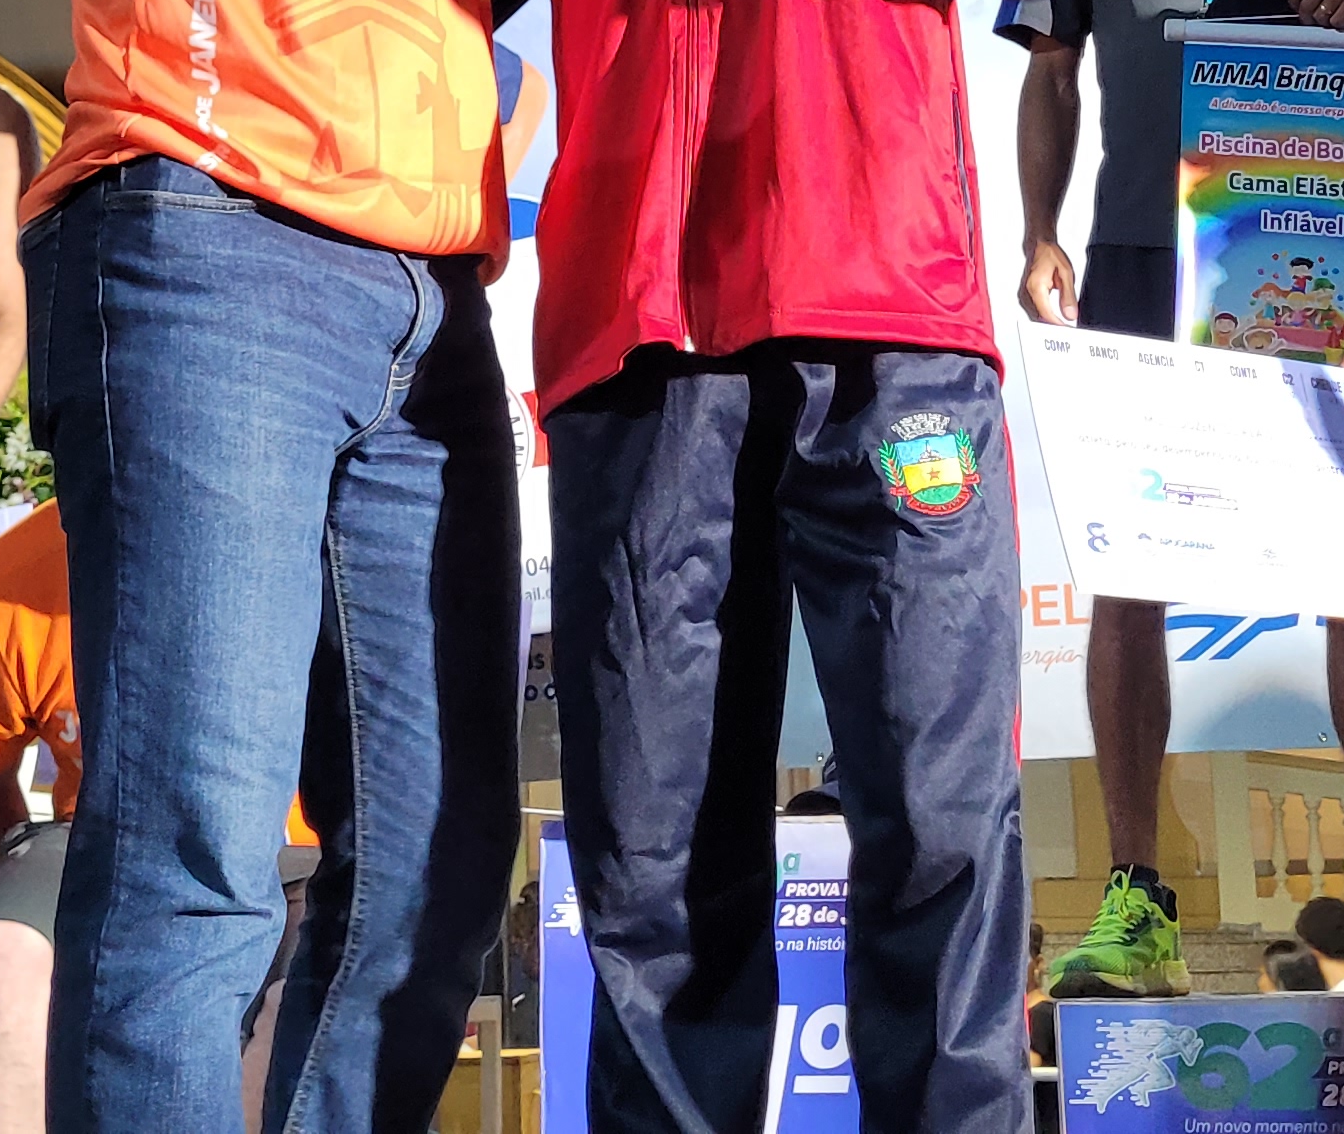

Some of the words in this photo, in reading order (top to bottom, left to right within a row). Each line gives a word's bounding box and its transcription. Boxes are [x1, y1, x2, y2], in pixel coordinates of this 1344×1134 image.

[1192, 63, 1268, 87] M.M.A
[1210, 98, 1219, 110] A
[1221, 99, 1268, 112] diversão
[1200, 133, 1277, 157] Piscina
[1283, 138, 1311, 158] de
[1228, 172, 1289, 194] Cama
[1044, 339, 1071, 354] COMP
[1089, 345, 1119, 360] BANCO
[1230, 365, 1258, 379] CONTA
[785, 882, 841, 898] PROVA
[778, 903, 812, 927] 28
[813, 908, 839, 925] de
[786, 939, 804, 952] na
[1184, 1119, 1211, 1133] Um
[1214, 1123, 1252, 1134] novo
[1255, 1120, 1328, 1134] momento
